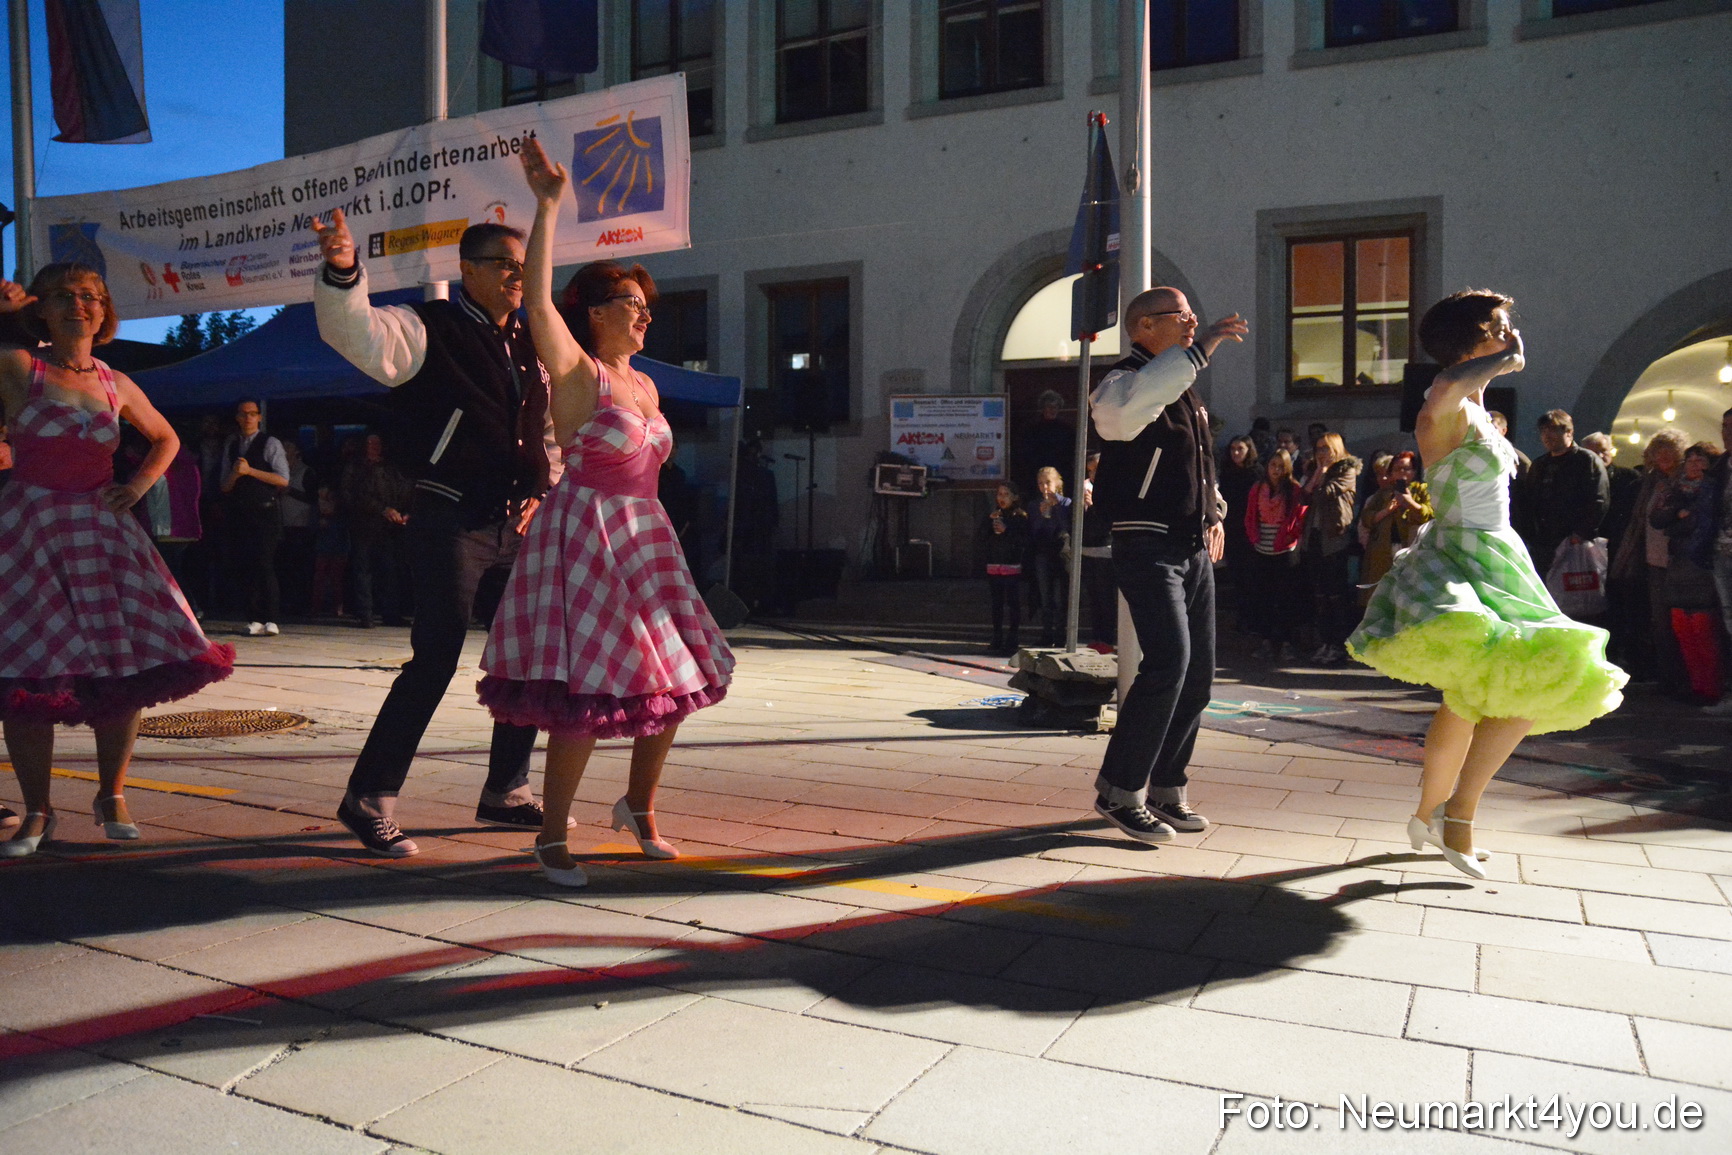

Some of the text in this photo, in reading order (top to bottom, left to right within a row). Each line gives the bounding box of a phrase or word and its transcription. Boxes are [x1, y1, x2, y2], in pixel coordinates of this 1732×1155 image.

[119, 186, 286, 230] Arbeitsgemeinschaft
[292, 176, 349, 203] offene
[178, 233, 199, 251] im
[205, 218, 286, 249] Landkreis
[291, 193, 372, 233] Neumrkt
[379, 178, 456, 212] i.d.OPf.
[388, 226, 462, 251] Regens Wagner
[289, 252, 324, 265] Nürnber
[290, 267, 318, 278] Neuma
[186, 282, 206, 292] Kreuz
